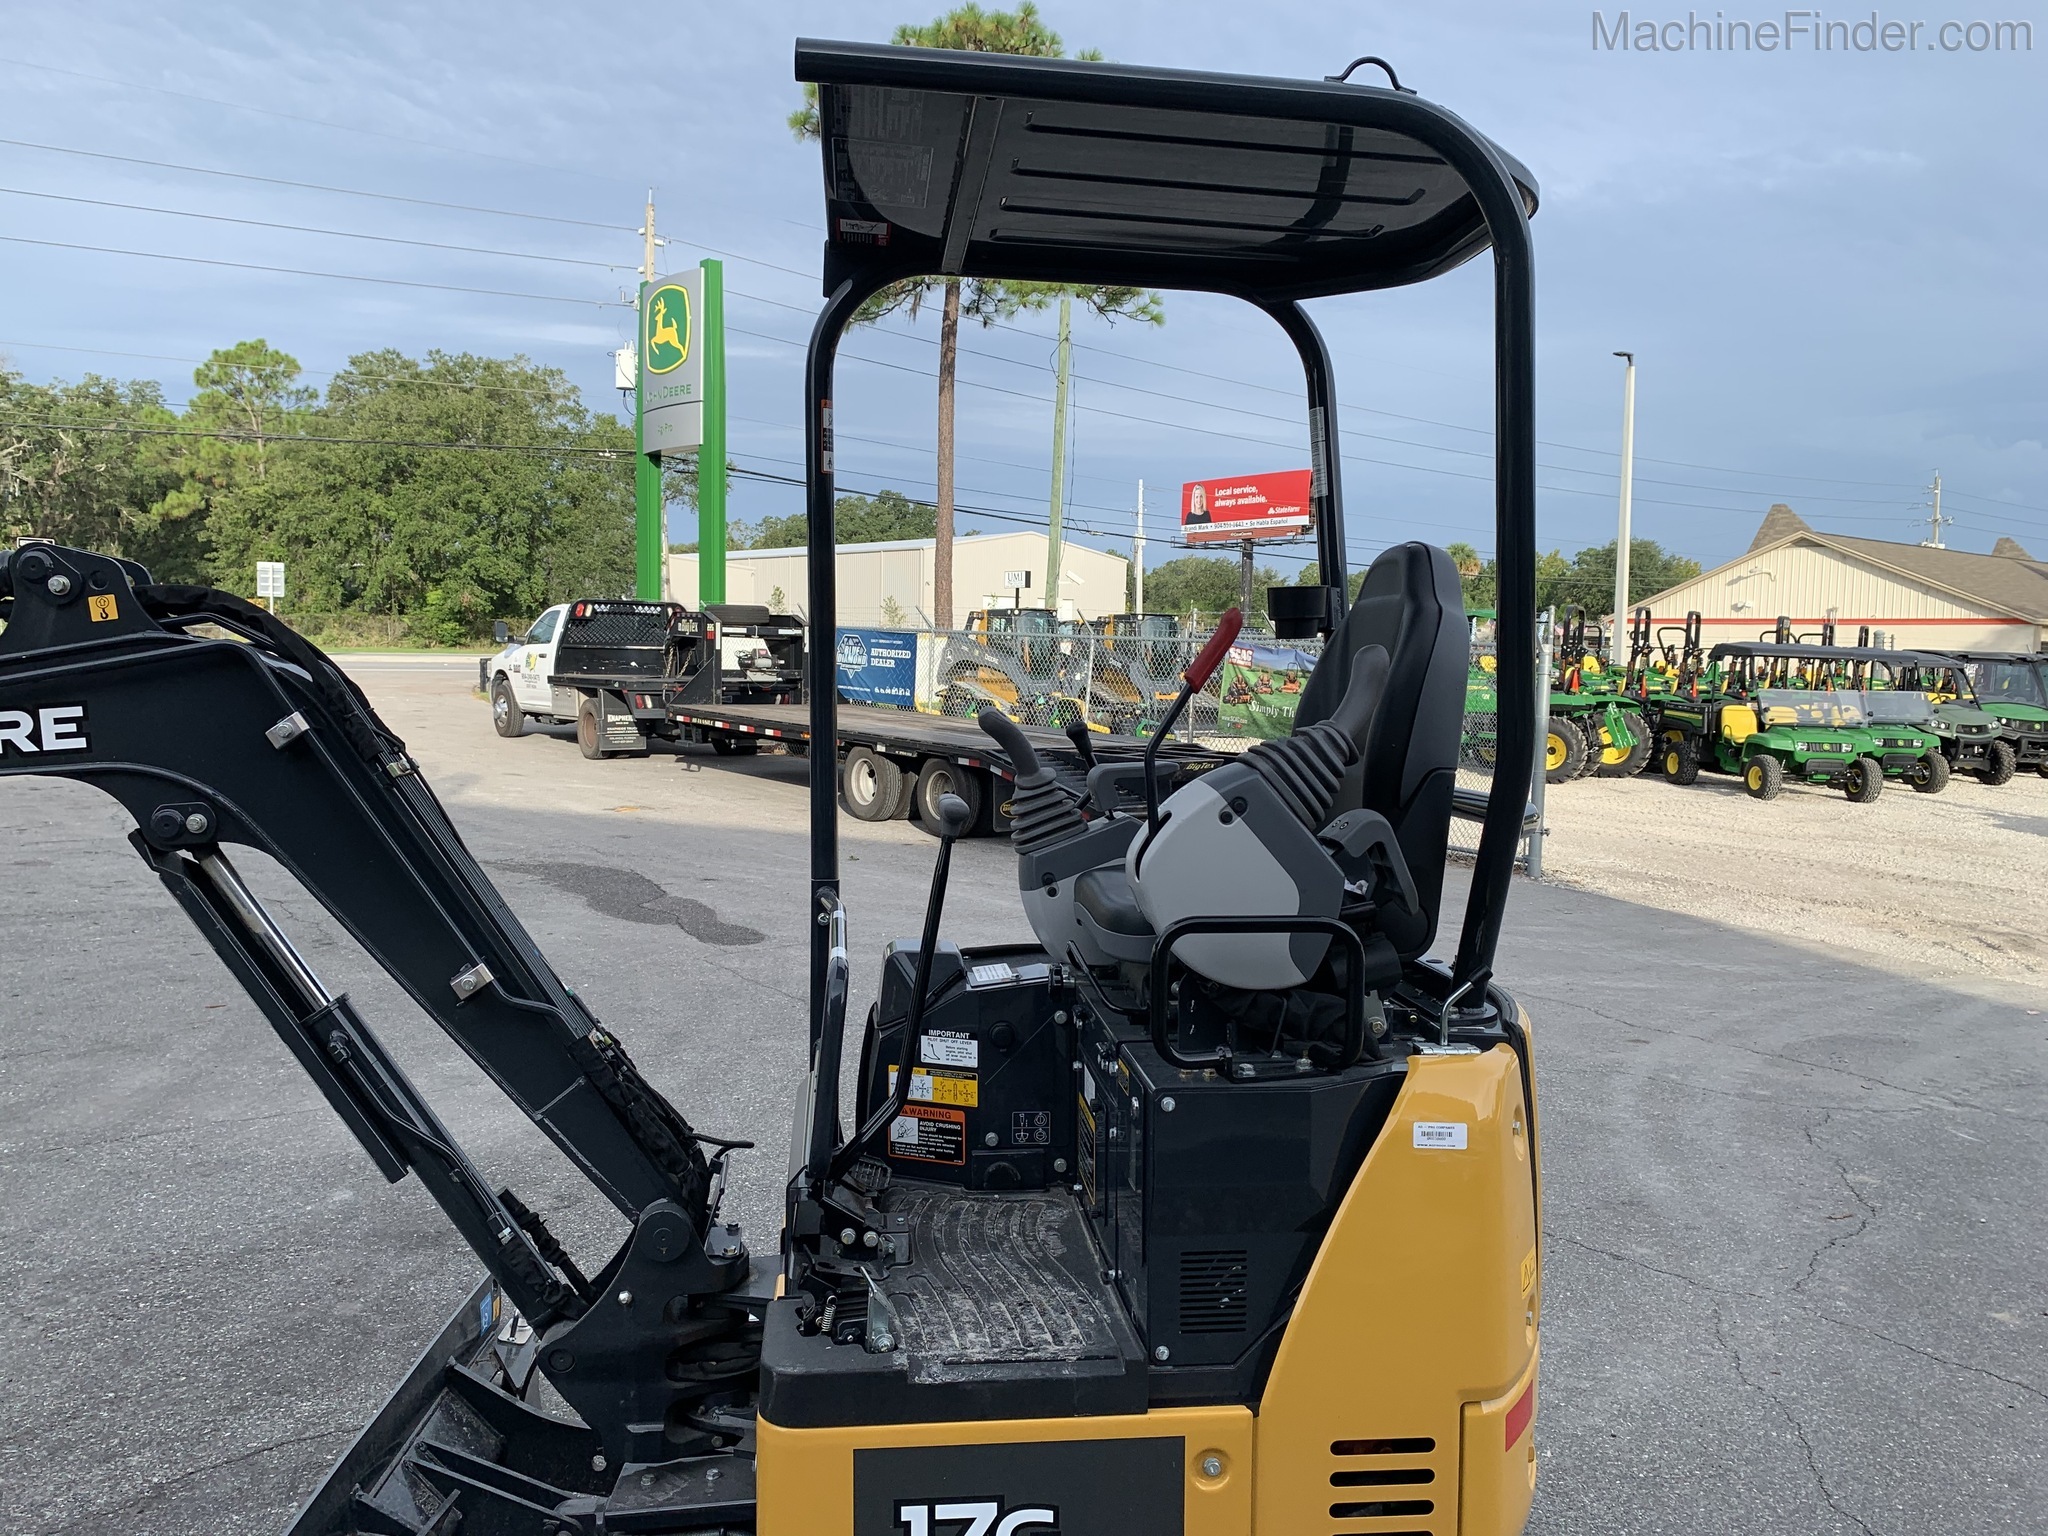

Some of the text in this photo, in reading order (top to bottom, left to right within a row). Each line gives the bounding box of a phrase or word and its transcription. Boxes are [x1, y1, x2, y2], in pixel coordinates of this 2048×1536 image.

[1214, 484, 1259, 497] Local service,
[1214, 494, 1268, 508] always available.
[870, 647, 912, 659] AUTHORIZED
[1229, 646, 1253, 661] SCAG
[870, 658, 896, 668] DEALER
[1249, 699, 1295, 718] Simply Th
[928, 1028, 970, 1040] IMPORTANT
[909, 1107, 952, 1119] WARNING
[935, 1122, 961, 1130] CRUSHING
